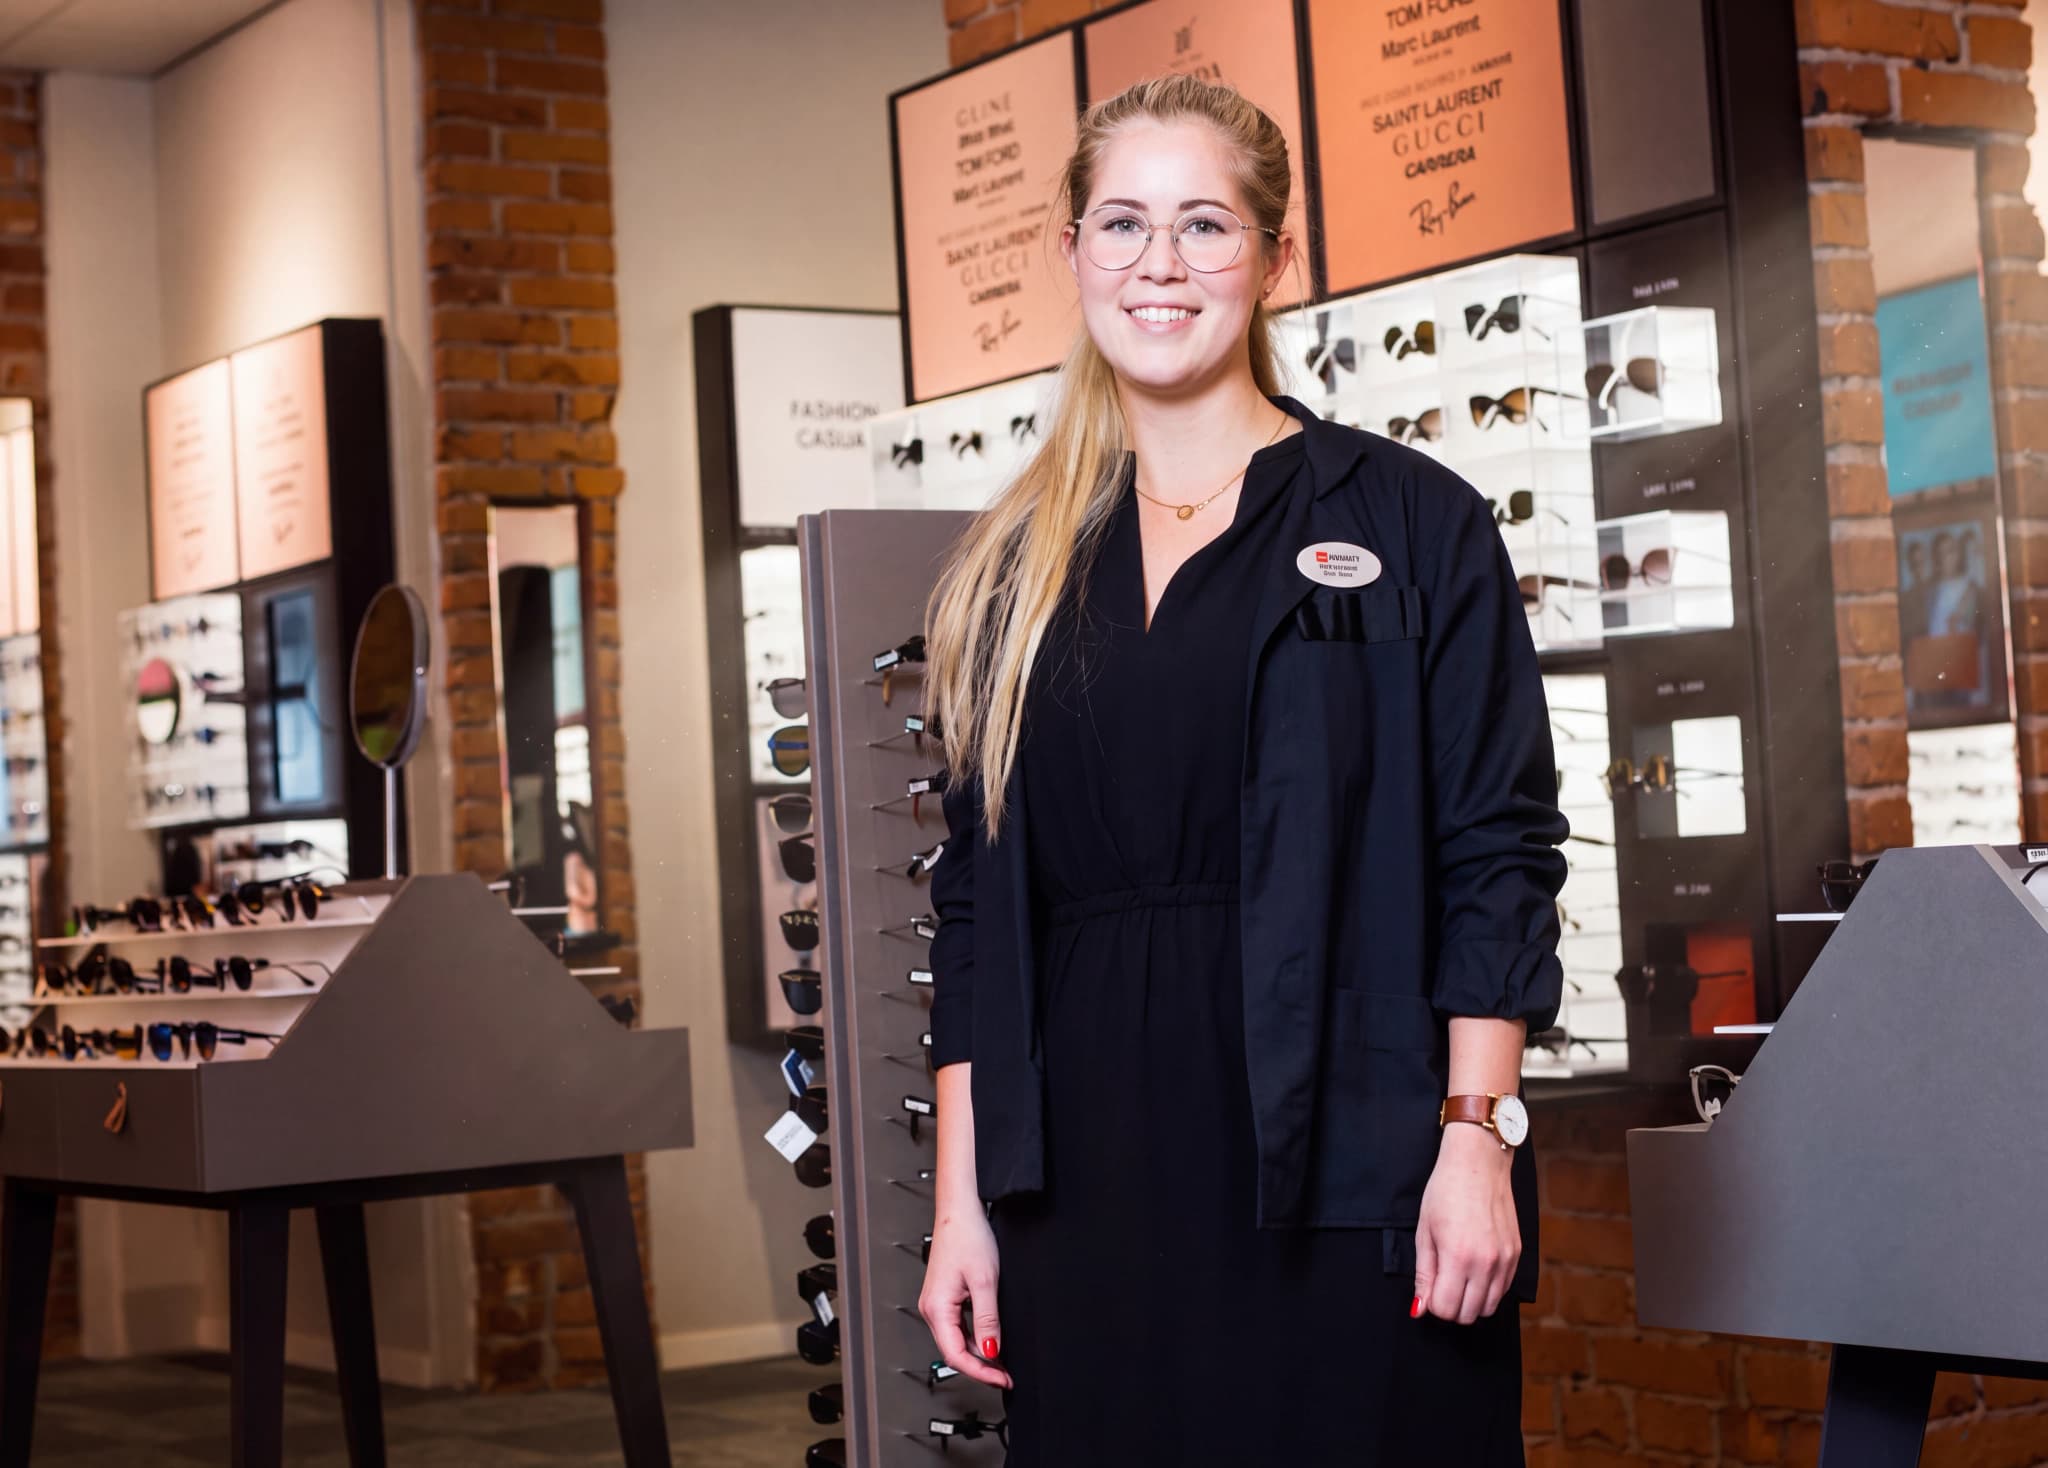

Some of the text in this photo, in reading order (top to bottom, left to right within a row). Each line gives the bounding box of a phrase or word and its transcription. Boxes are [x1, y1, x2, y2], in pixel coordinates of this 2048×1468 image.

[1386, 0, 1422, 30] TOM
[1422, 14, 1480, 48] Laurent
[1373, 102, 1420, 134] SAINT
[1424, 79, 1503, 119] LAURENT
[1393, 111, 1485, 157] GUCCI
[945, 242, 980, 267] SAINT
[984, 223, 1043, 256] LAURENT
[960, 250, 1029, 287] GUCCI
[790, 399, 880, 421] FASHION
[795, 427, 866, 450] CASUA
